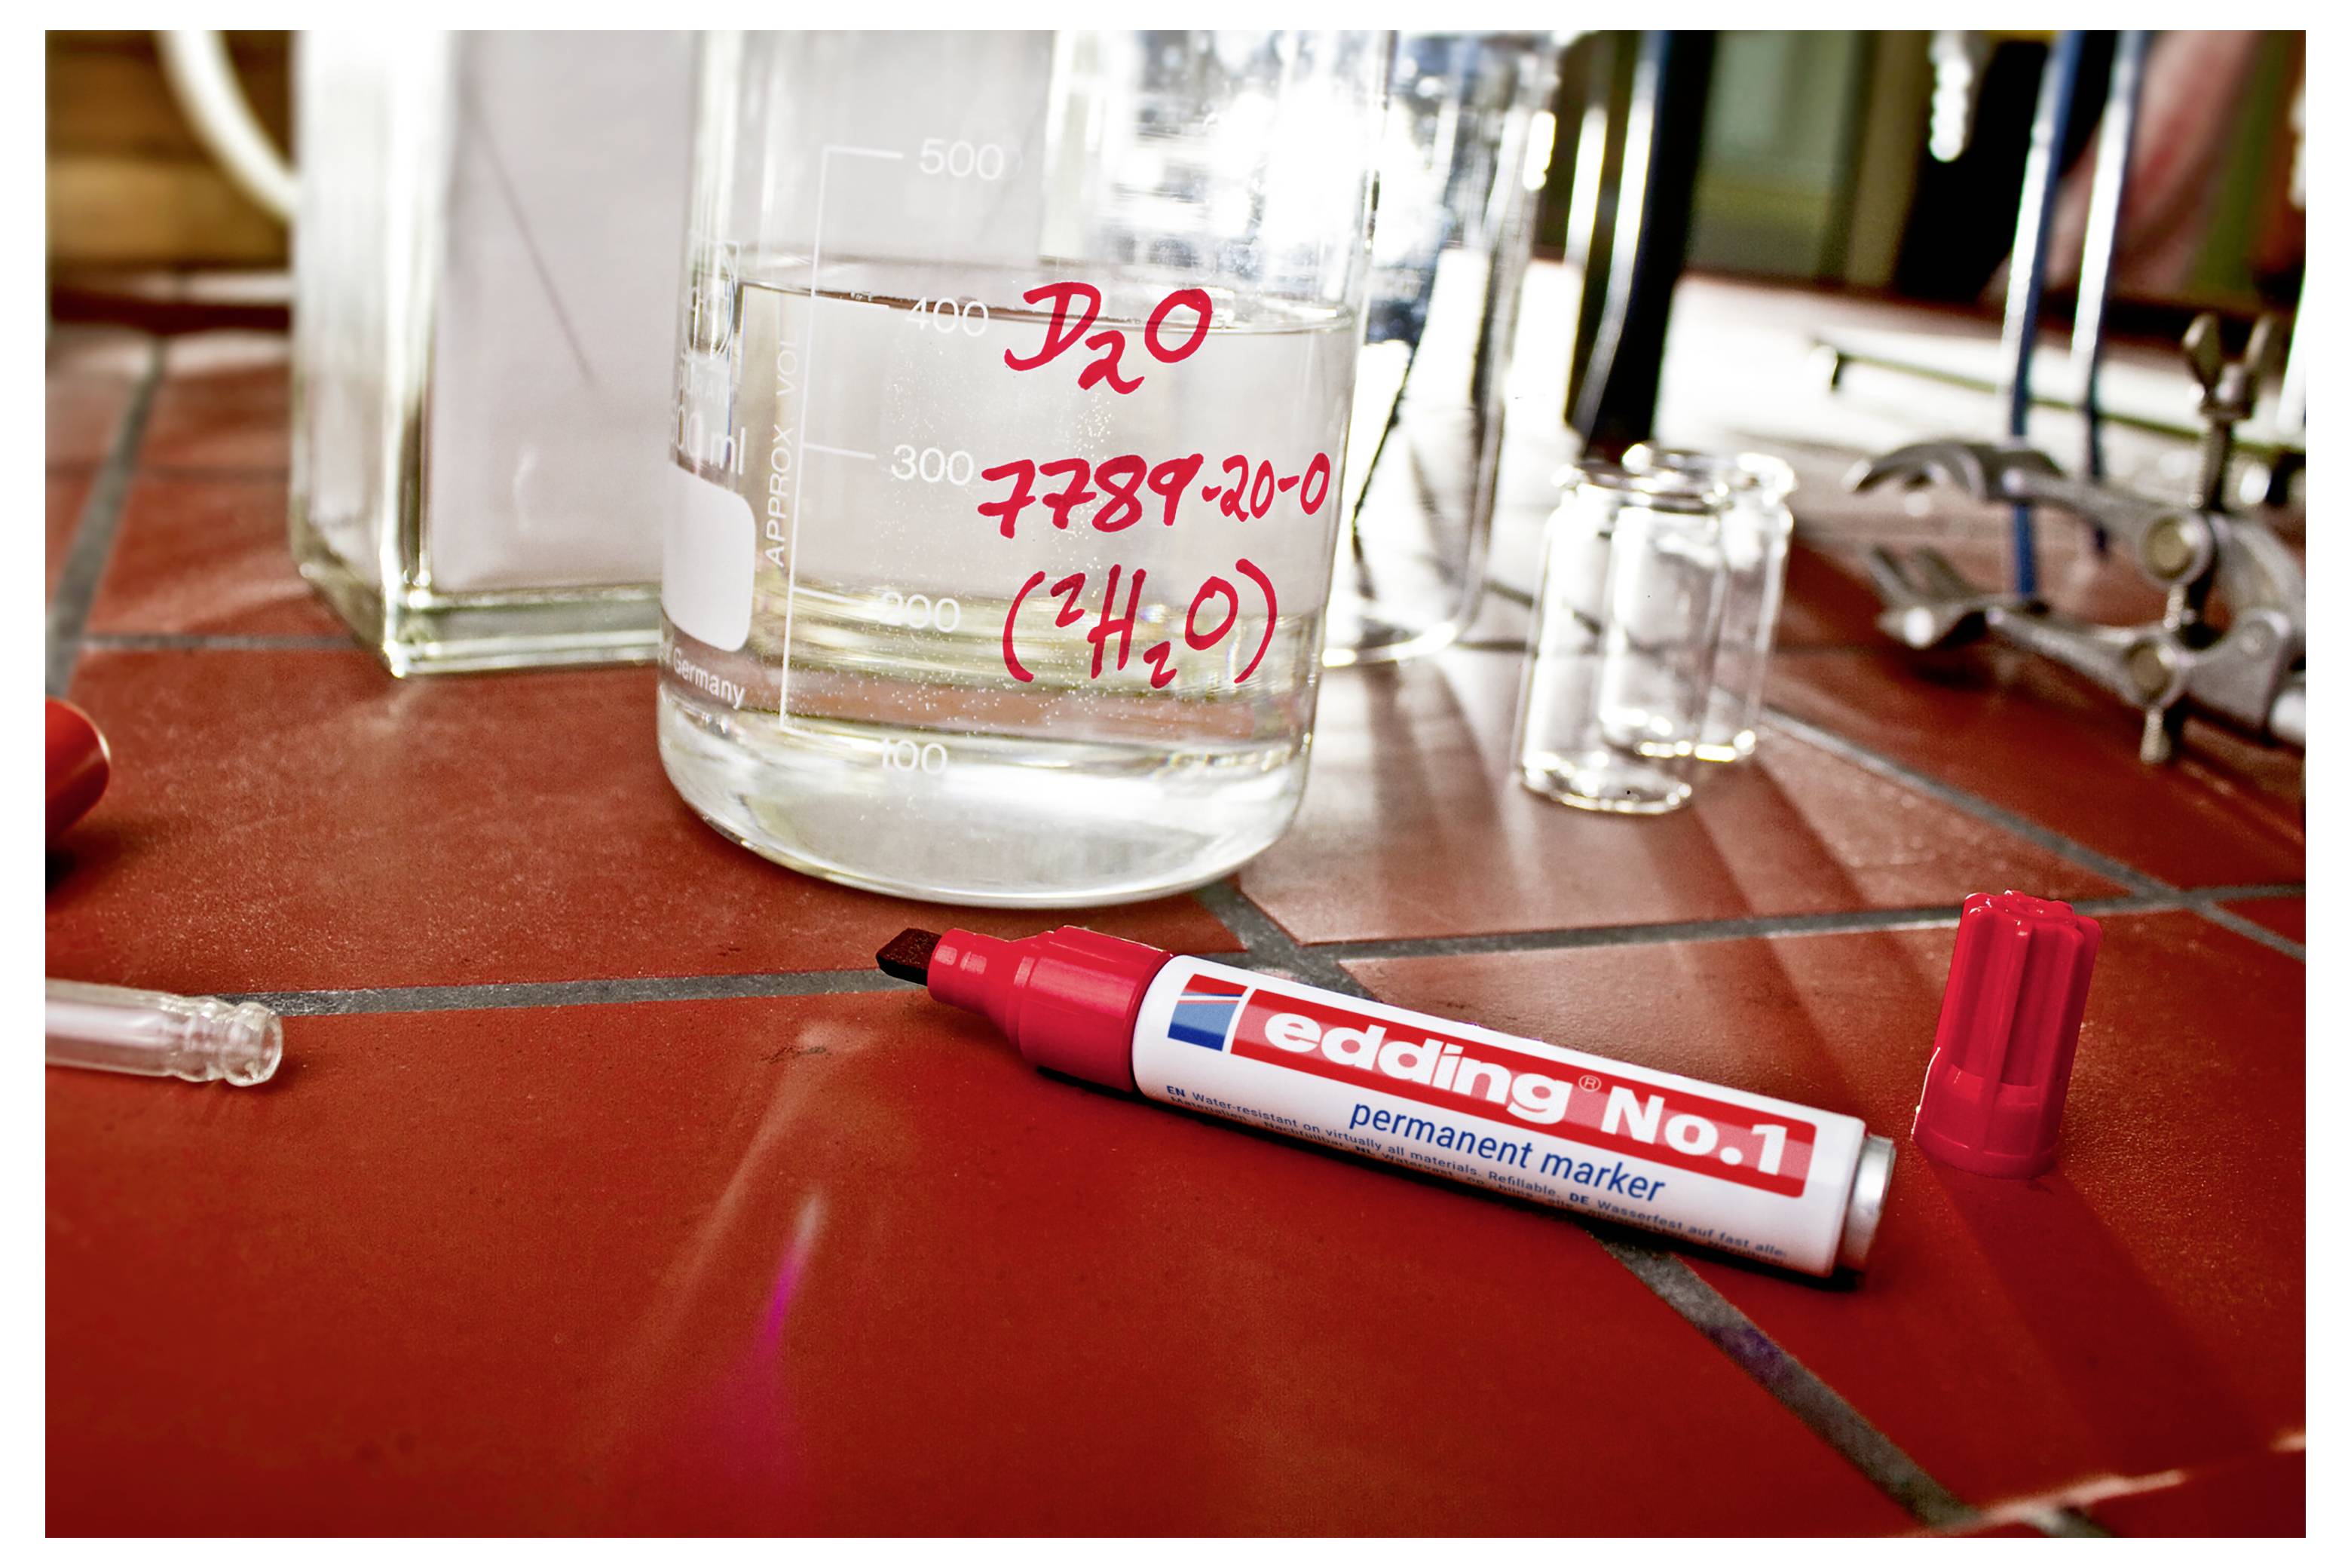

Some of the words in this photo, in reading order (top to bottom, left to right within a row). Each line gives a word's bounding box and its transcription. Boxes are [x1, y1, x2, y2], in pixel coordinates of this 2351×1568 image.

[918, 138, 1005, 180] 500
[905, 297, 990, 337] 400
[764, 424, 794, 568] APPROX
[891, 444, 975, 486] 300
[977, 452, 1331, 539] 7789-20-0
[880, 590, 961, 633] 200
[673, 646, 746, 710] Germany
[881, 737, 948, 776] 100
[1166, 1085, 1186, 1098] EN
[1191, 1092, 1298, 1128] Water-resistant
[1303, 1123, 1321, 1133] on
[1325, 1129, 1382, 1150] virtually
[1388, 1144, 1405, 1156] all
[1569, 1192, 1590, 1205] DE
[1349, 1103, 1532, 1169] permanent
[1540, 1152, 1666, 1202] marker
[1600, 1086, 1787, 1175] No.1
